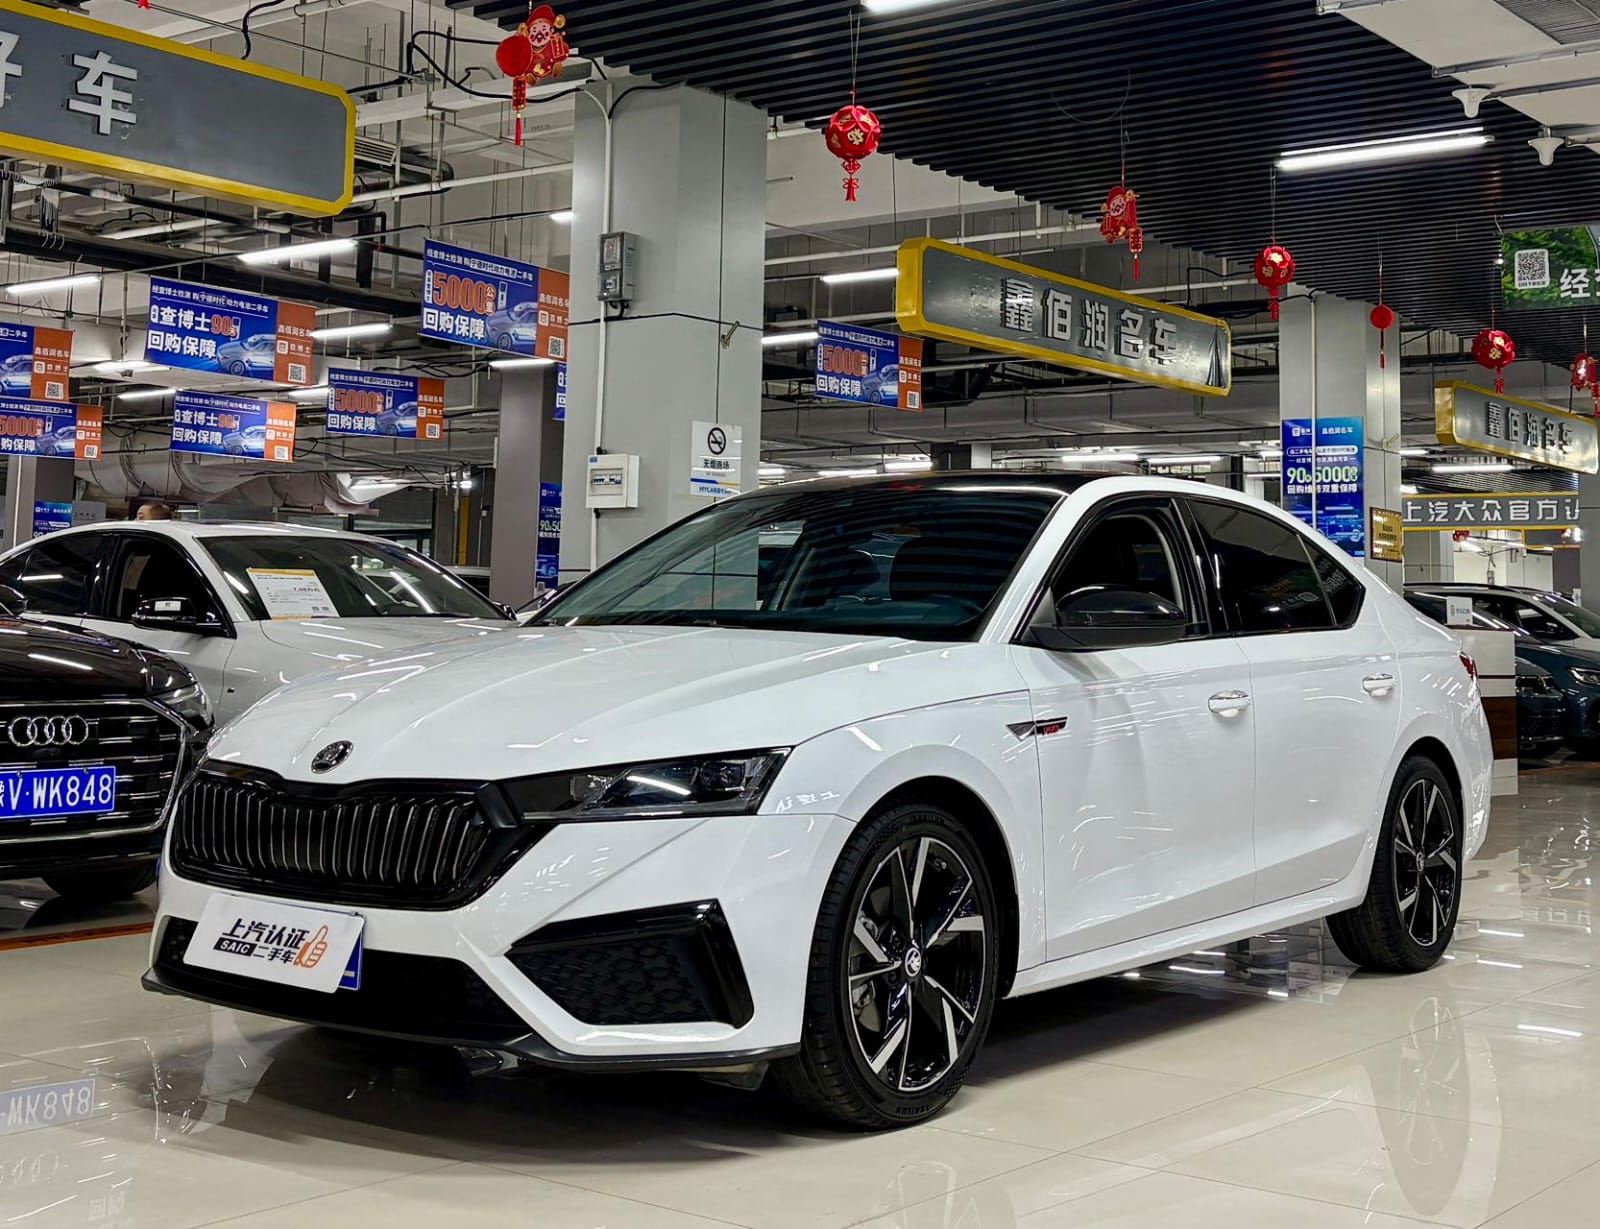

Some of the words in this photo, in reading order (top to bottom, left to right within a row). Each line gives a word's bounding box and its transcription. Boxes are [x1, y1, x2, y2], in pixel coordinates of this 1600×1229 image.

[433, 271, 496, 316] 5000公里
[1560, 268, 1600, 298] 经
[423, 308, 485, 339] 回购保障
[1004, 277, 1177, 365] 鑫佰润名车
[148, 330, 216, 358] 回购保障
[816, 374, 861, 397] 回购保障
[172, 427, 223, 445] 回购保障
[327, 414, 376, 431] 回购保障
[222, 918, 310, 949] 上汽认证
[219, 939, 251, 955] SAIC
[253, 946, 297, 964] 二手车
